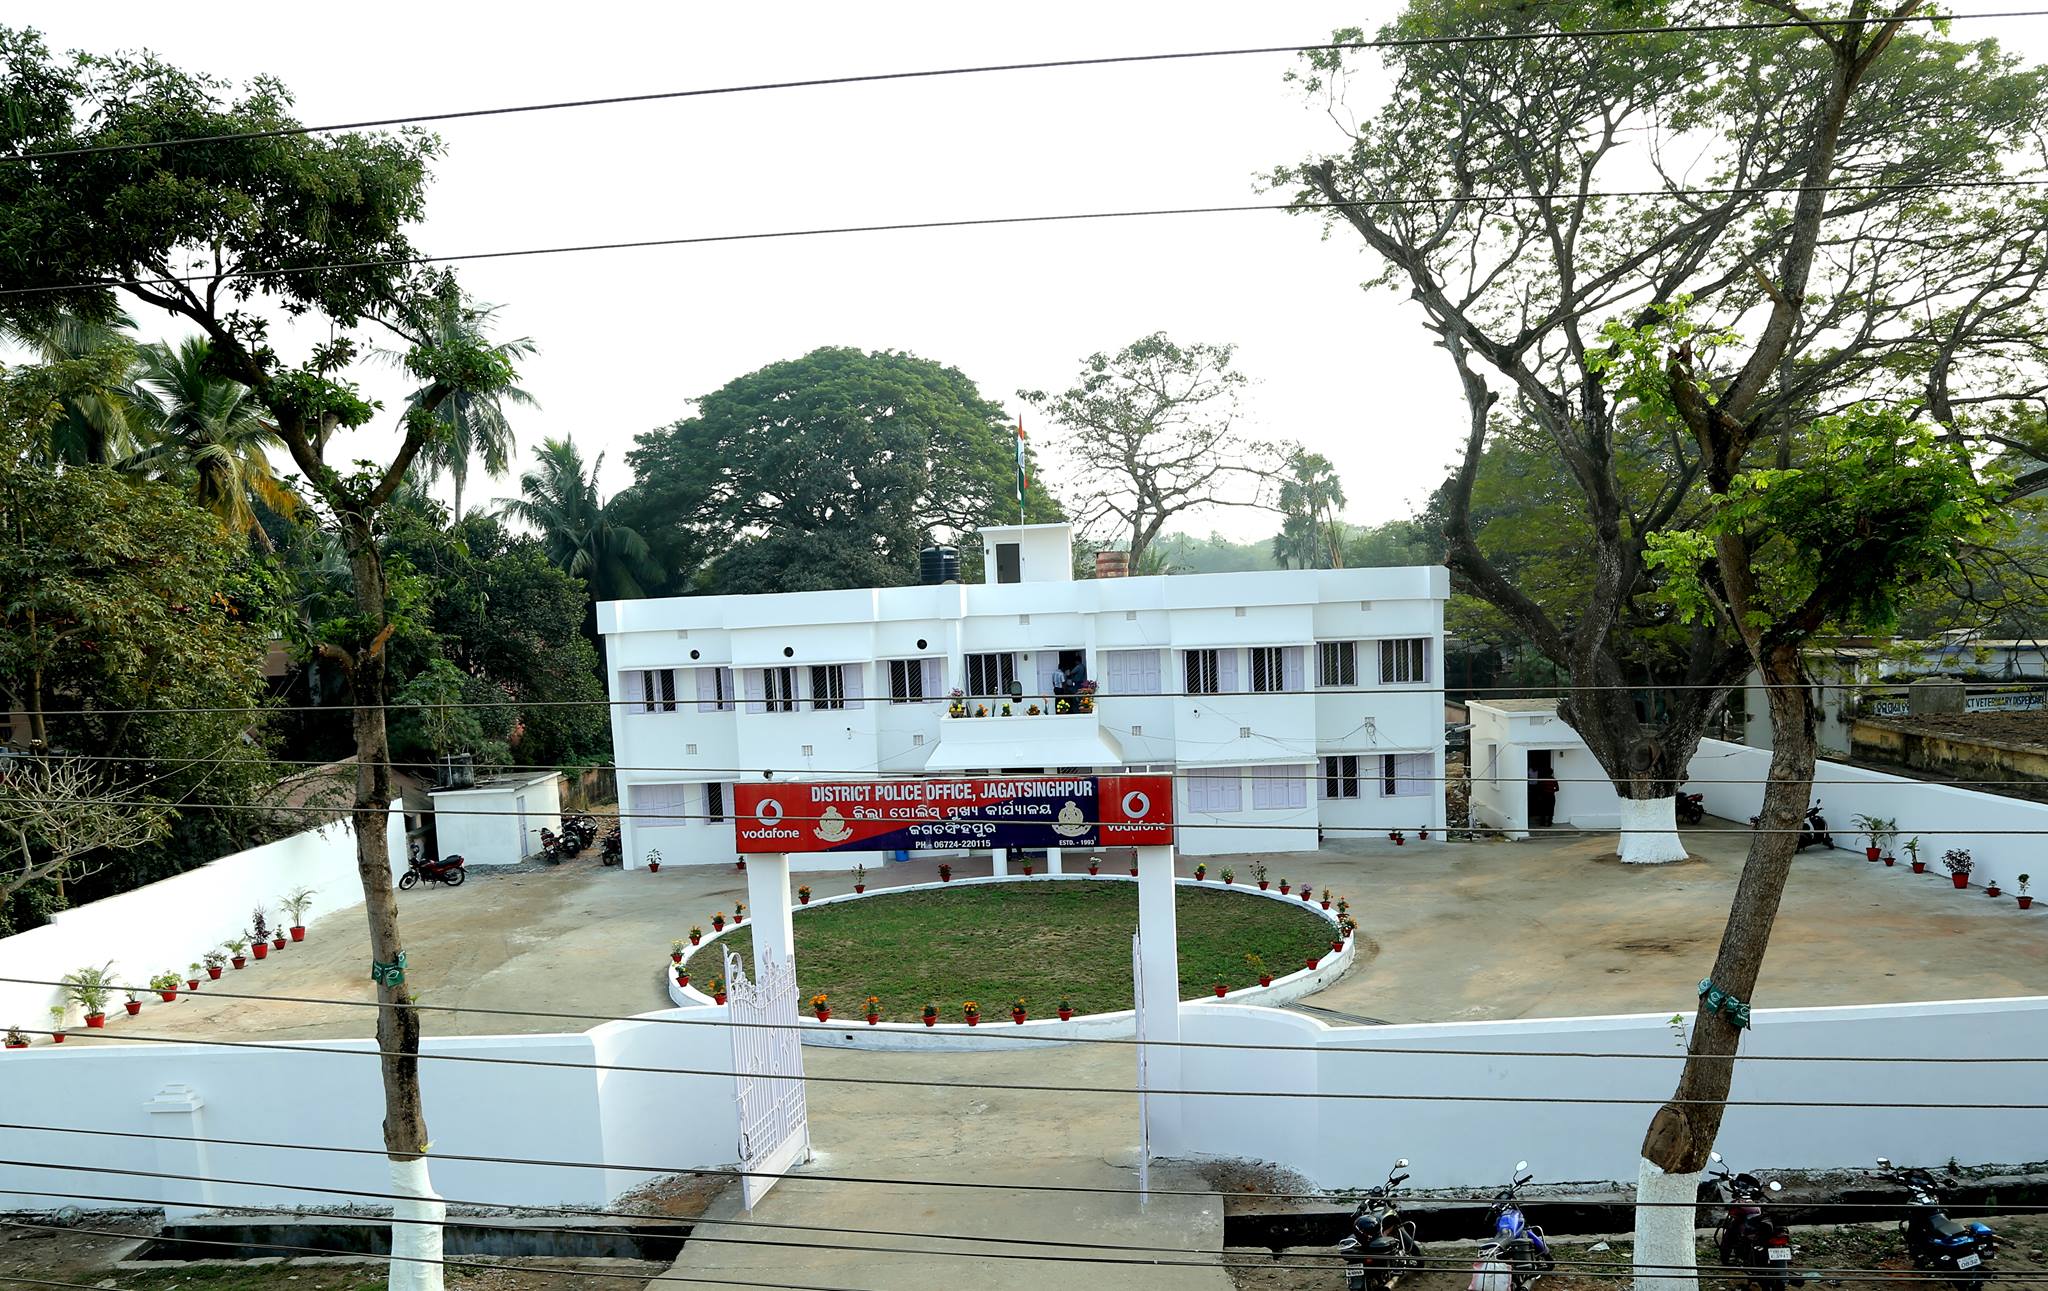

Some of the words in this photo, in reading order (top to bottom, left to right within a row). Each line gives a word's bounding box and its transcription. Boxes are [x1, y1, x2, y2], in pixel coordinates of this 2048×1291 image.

[811, 785, 871, 802] DISTRICT
[875, 784, 922, 801] POLICE
[926, 782, 977, 801] OFFICE,
[979, 780, 1093, 799] JAGATSINGHPUR
[741, 827, 800, 839] vodafone
[934, 839, 991, 849] 06724-220115
